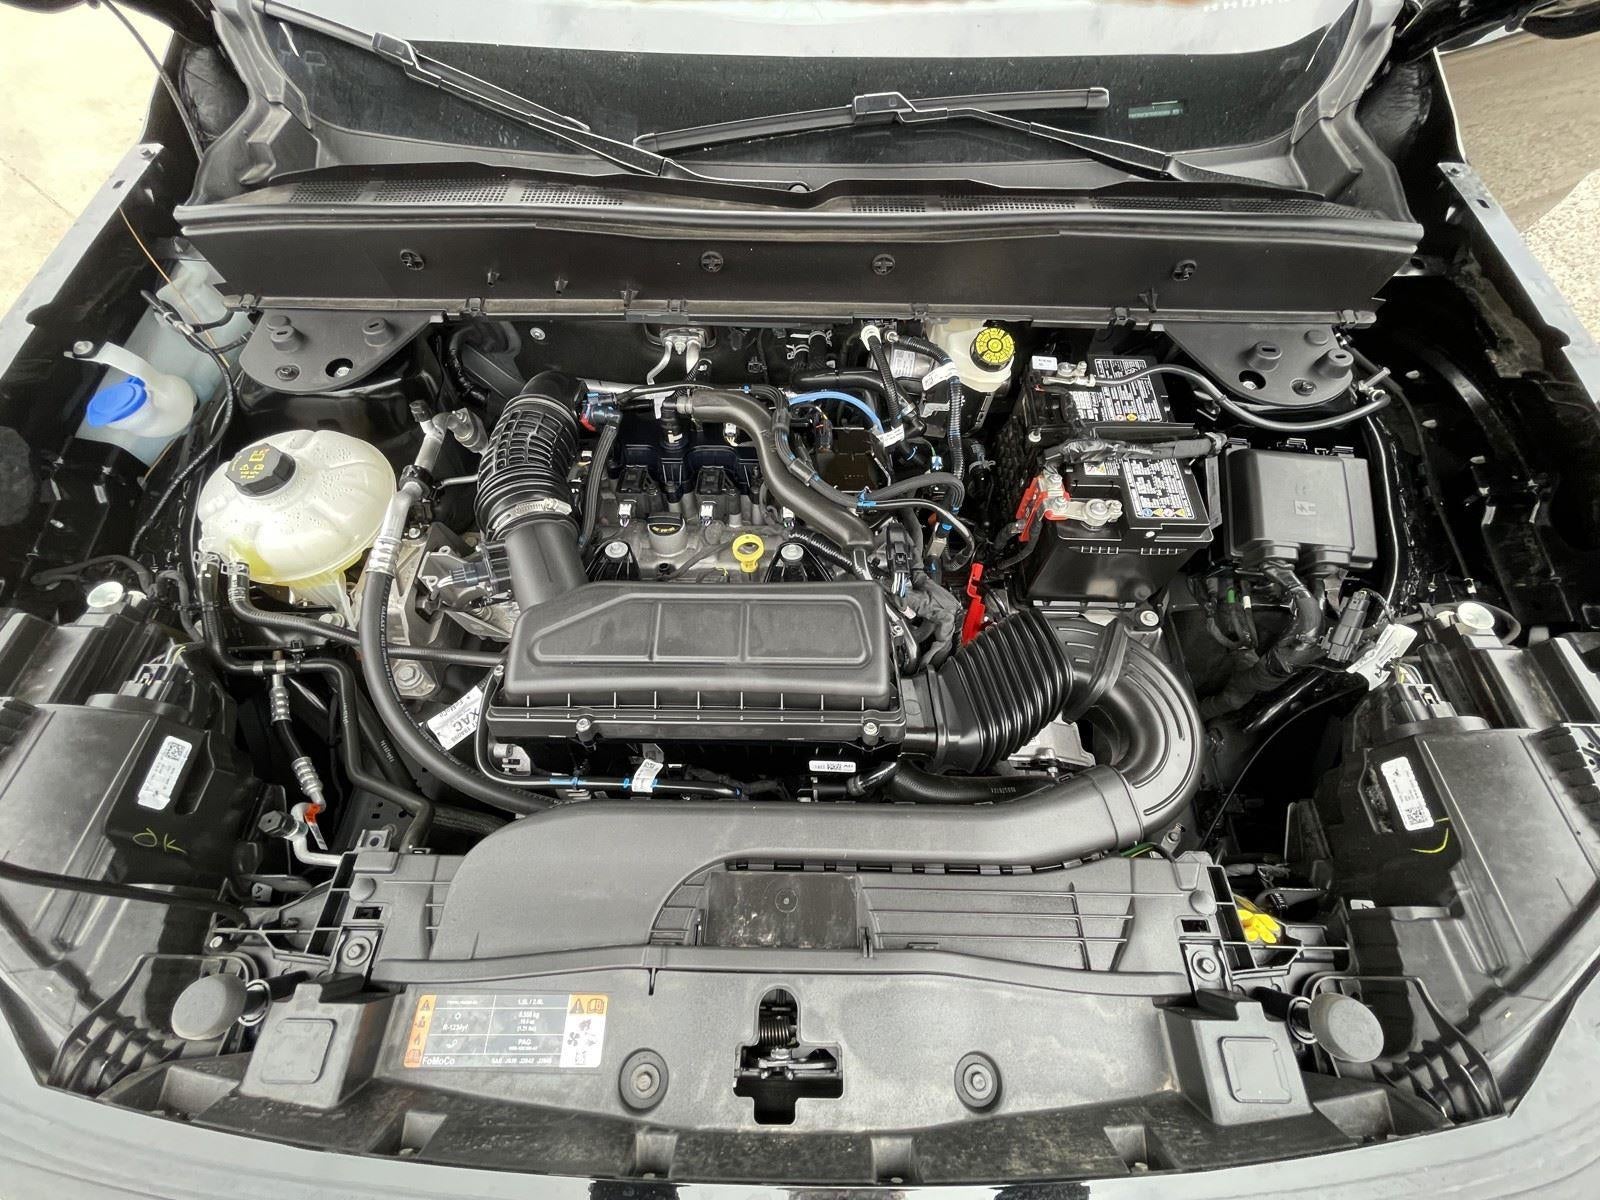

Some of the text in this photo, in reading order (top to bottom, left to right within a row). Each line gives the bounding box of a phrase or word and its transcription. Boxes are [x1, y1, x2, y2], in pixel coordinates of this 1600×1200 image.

[453, 707, 480, 732] XAC
[132, 827, 188, 855] OK
[422, 1055, 455, 1066] FoMoCo
